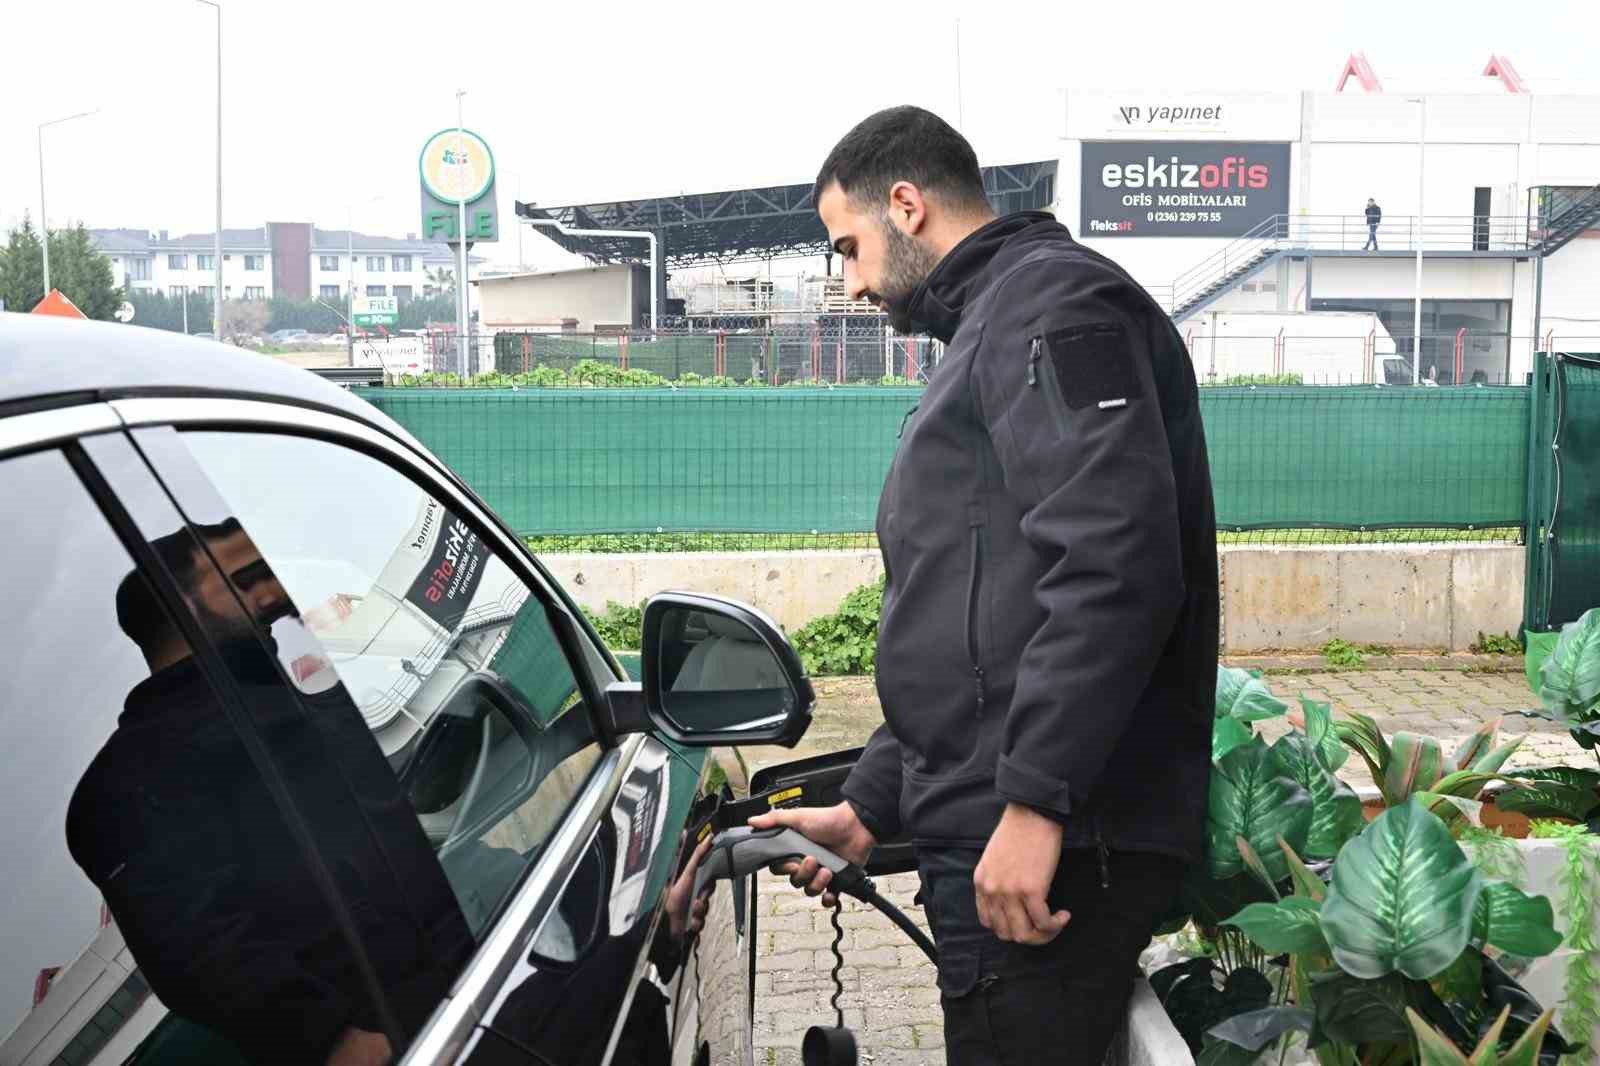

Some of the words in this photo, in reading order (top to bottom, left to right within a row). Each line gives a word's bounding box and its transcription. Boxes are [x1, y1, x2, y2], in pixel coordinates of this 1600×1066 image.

[1102, 156, 1269, 189] eskizofis
[1122, 193, 1153, 206] OFİS
[1158, 193, 1247, 207] MOBİLYALARI
[1147, 212, 1153, 221] 0
[1155, 212, 1178, 222] (236)
[1179, 212, 1196, 221] 239
[1197, 212, 1209, 221] 75
[1210, 212, 1221, 221] 55
